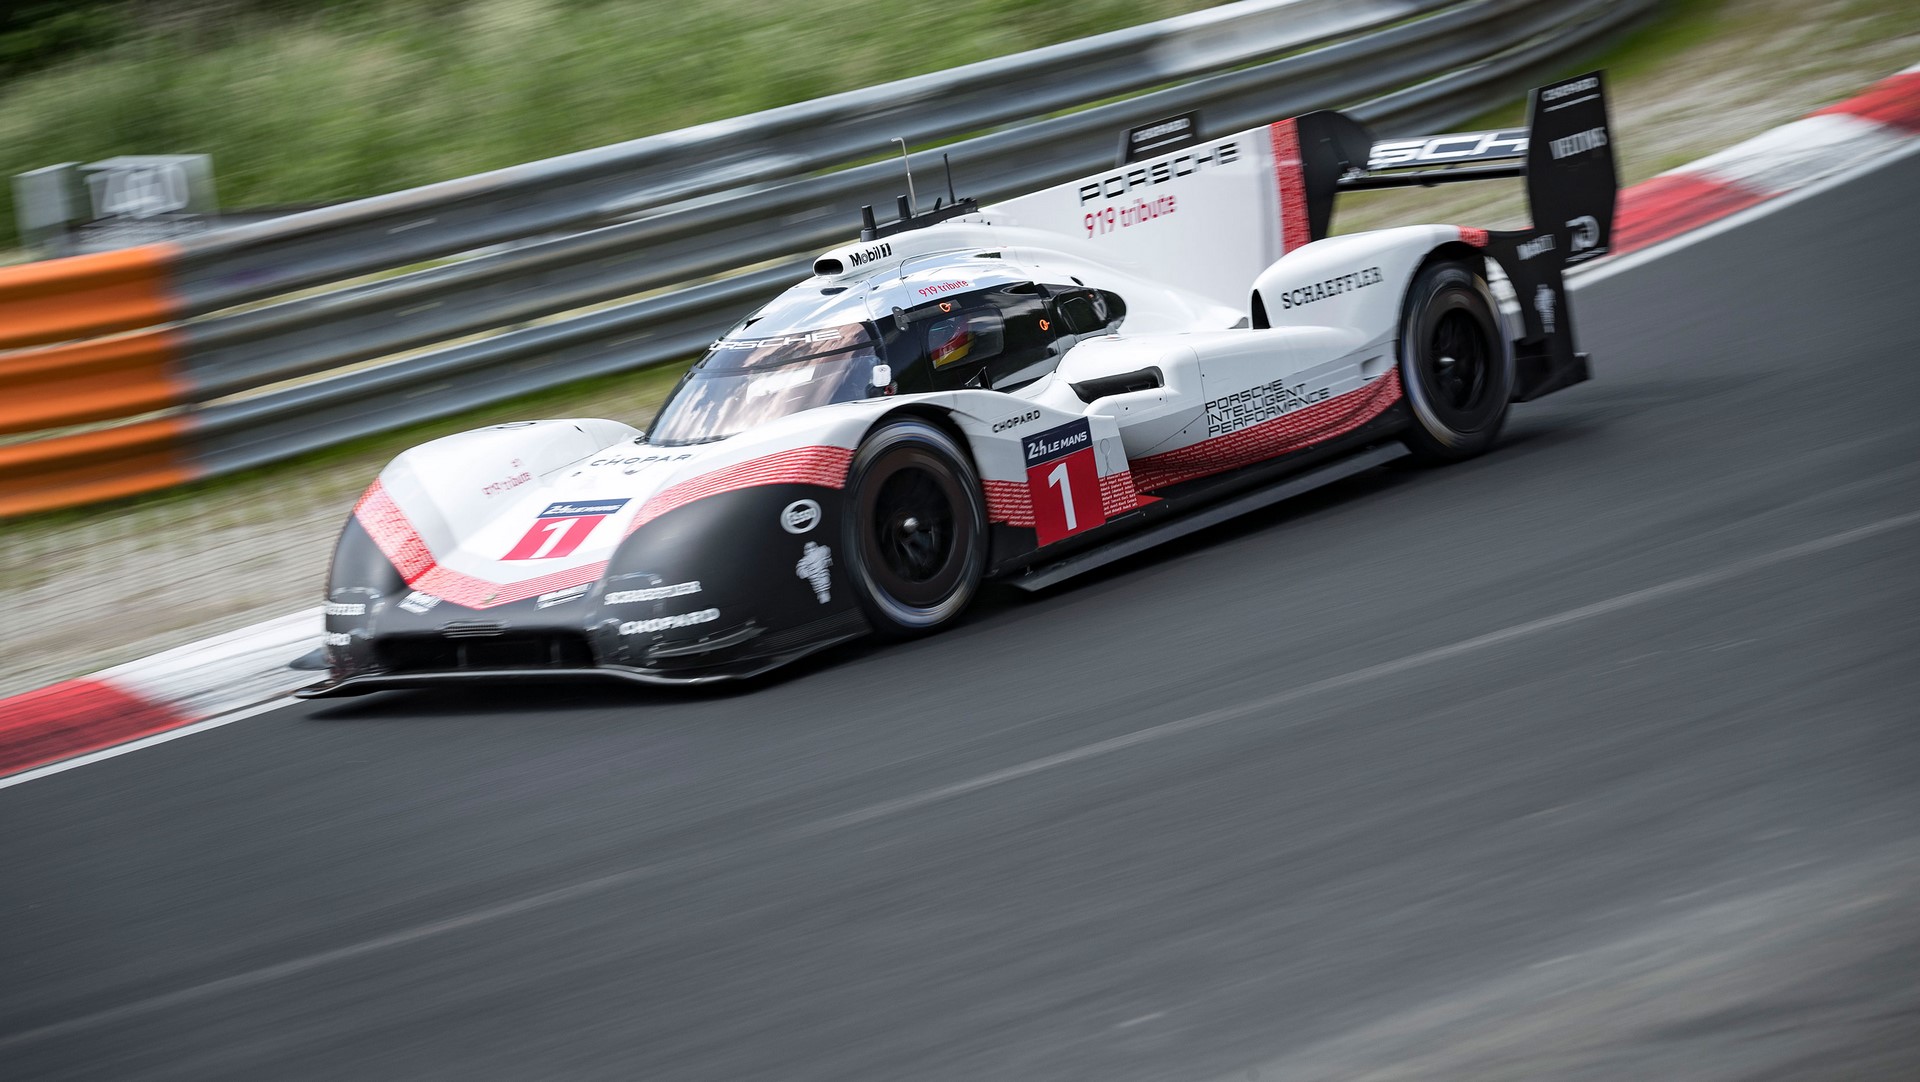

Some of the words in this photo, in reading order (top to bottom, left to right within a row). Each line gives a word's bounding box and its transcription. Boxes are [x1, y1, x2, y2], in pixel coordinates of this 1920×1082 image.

[1367, 132, 1530, 169] SCH
[1078, 141, 1241, 207] PORSCHE
[1084, 206, 1116, 239] 919
[1120, 194, 1177, 228] tribute
[918, 285, 939, 298] 919
[937, 279, 970, 294] tribute
[1281, 266, 1384, 310] SCHAEFFLER
[1205, 378, 1283, 414] PORSCHE
[1207, 383, 1306, 425] INTELLIGENT
[1208, 387, 1330, 438] PERFORMANCE
[992, 409, 1042, 433] CHOPARD
[1060, 431, 1089, 448] MANS
[1047, 462, 1078, 531] 1
[528, 518, 580, 559] 1
